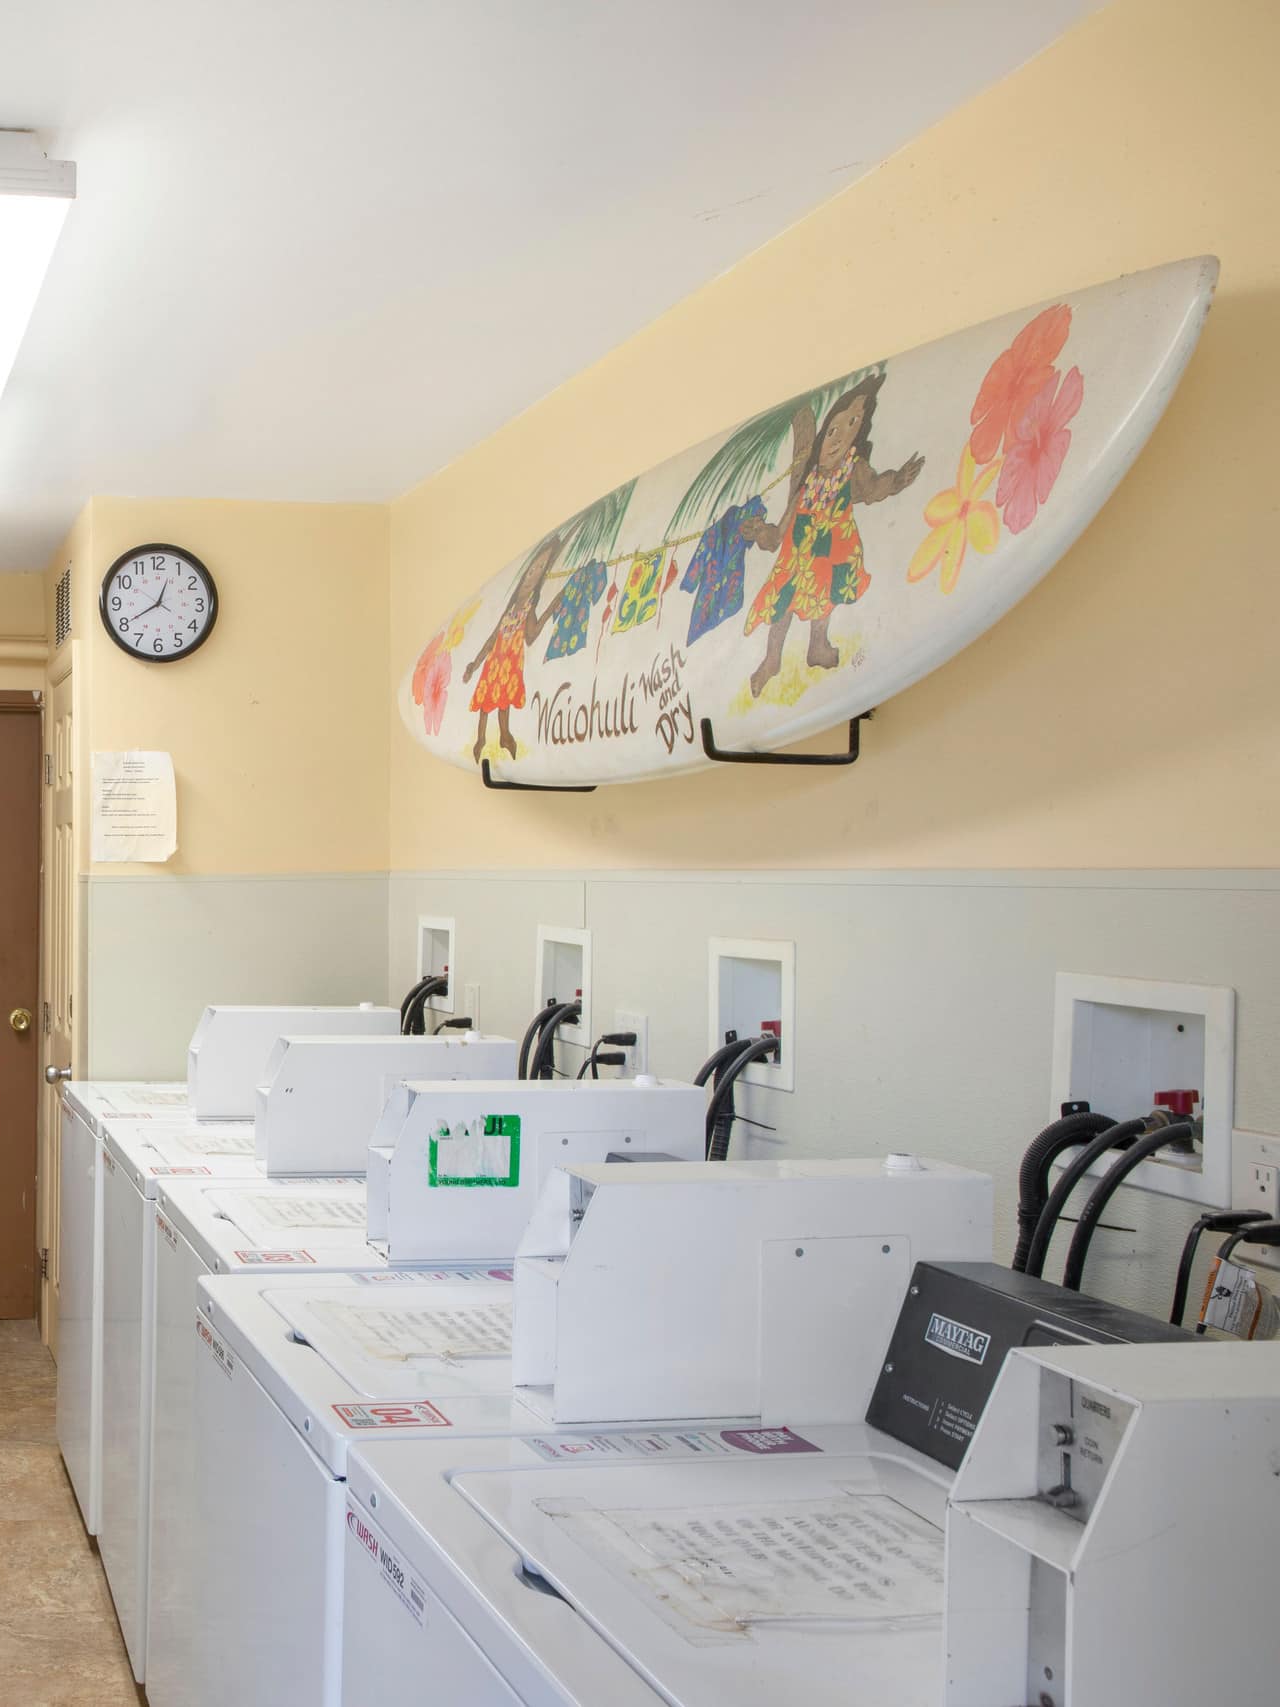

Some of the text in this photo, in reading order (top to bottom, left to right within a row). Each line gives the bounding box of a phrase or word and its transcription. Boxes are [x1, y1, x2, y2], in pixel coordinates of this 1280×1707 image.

[132, 561, 145, 576] 11
[150, 556, 166, 571] 12
[175, 561, 181, 576] 1
[116, 575, 132, 590] 10
[187, 575, 198, 591] 2
[111, 596, 122, 611] 9
[194, 597, 205, 613] 3
[119, 617, 129, 632] 8
[187, 619, 199, 633] 4
[133, 633, 144, 647] 7
[153, 638, 163, 653] 6
[173, 633, 183, 648] 5
[639, 642, 687, 704] Wash
[659, 668, 681, 710] and
[531, 673, 639, 745] Waiohuli
[655, 691, 694, 755] Dry
[931, 1318, 985, 1353] MAYTAG
[356, 1519, 378, 1557] WASH
